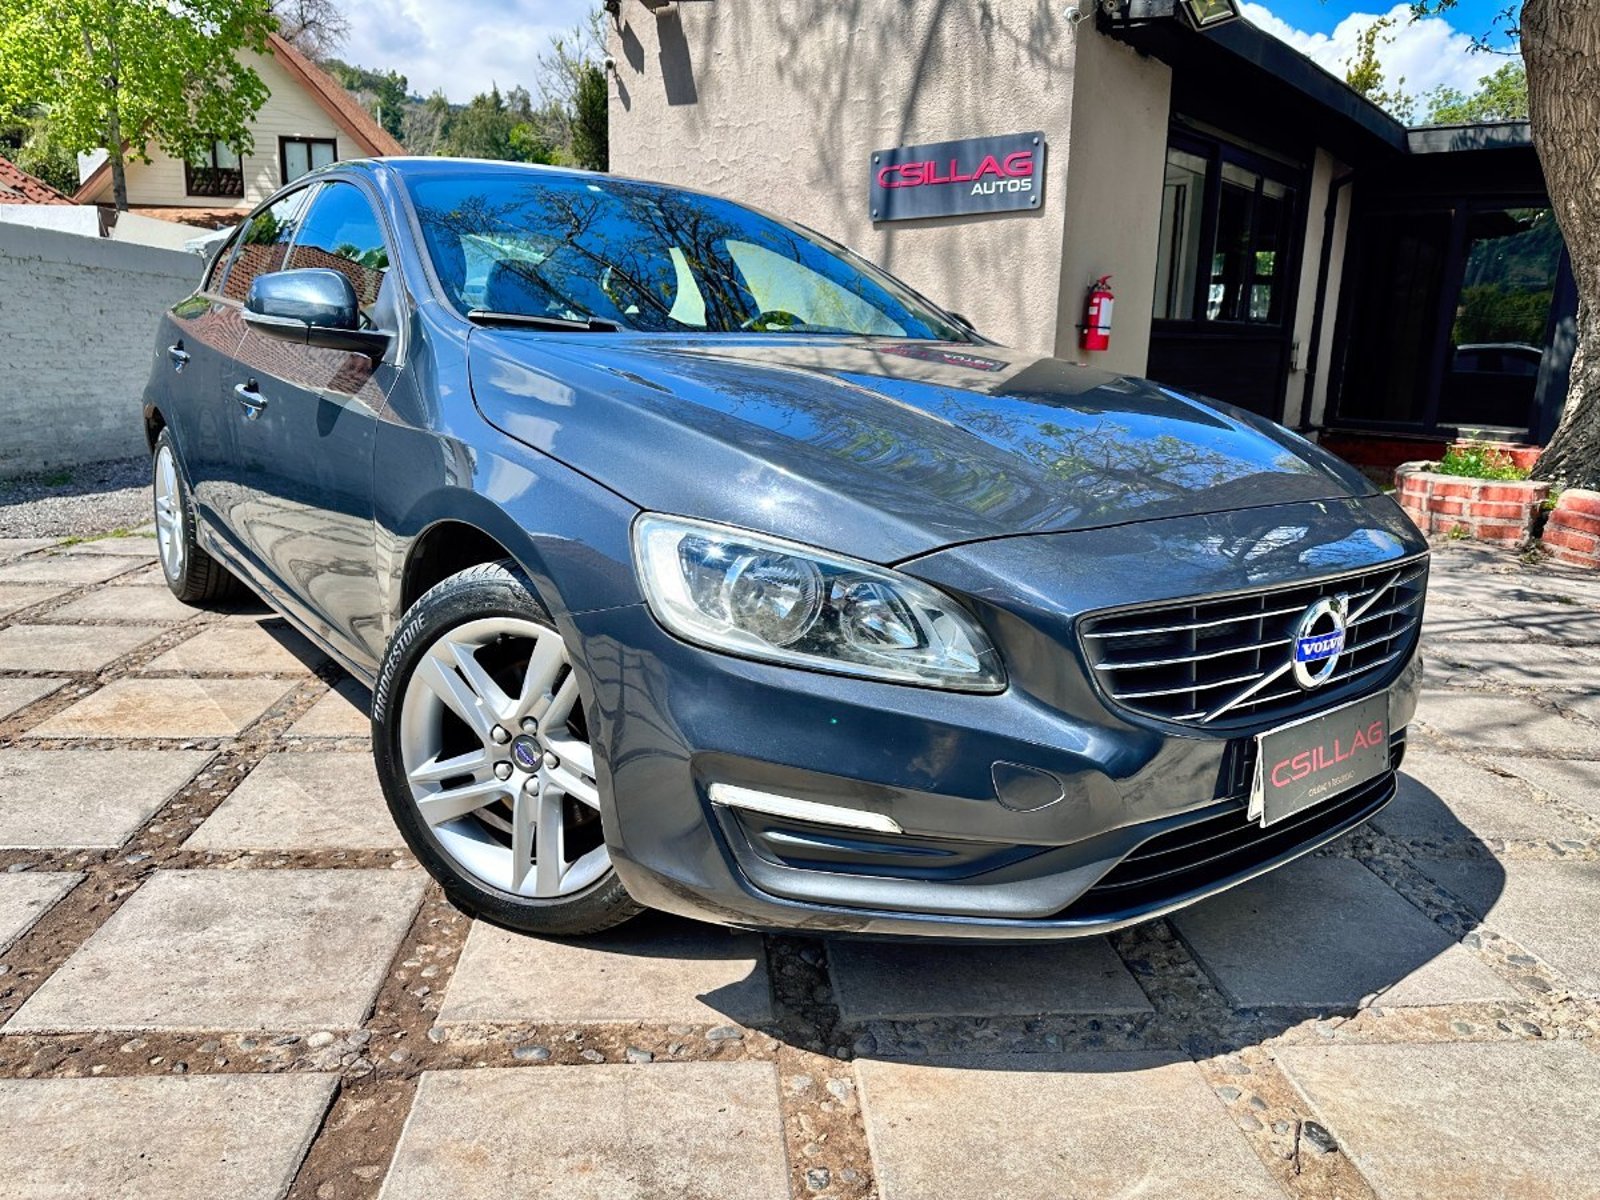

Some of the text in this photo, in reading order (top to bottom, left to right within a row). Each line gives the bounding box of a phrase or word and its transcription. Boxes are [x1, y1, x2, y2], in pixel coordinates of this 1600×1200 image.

[878, 152, 1033, 188] CSILLAG
[971, 179, 1032, 196] AUTOS
[1271, 720, 1385, 788] CSILLAG
